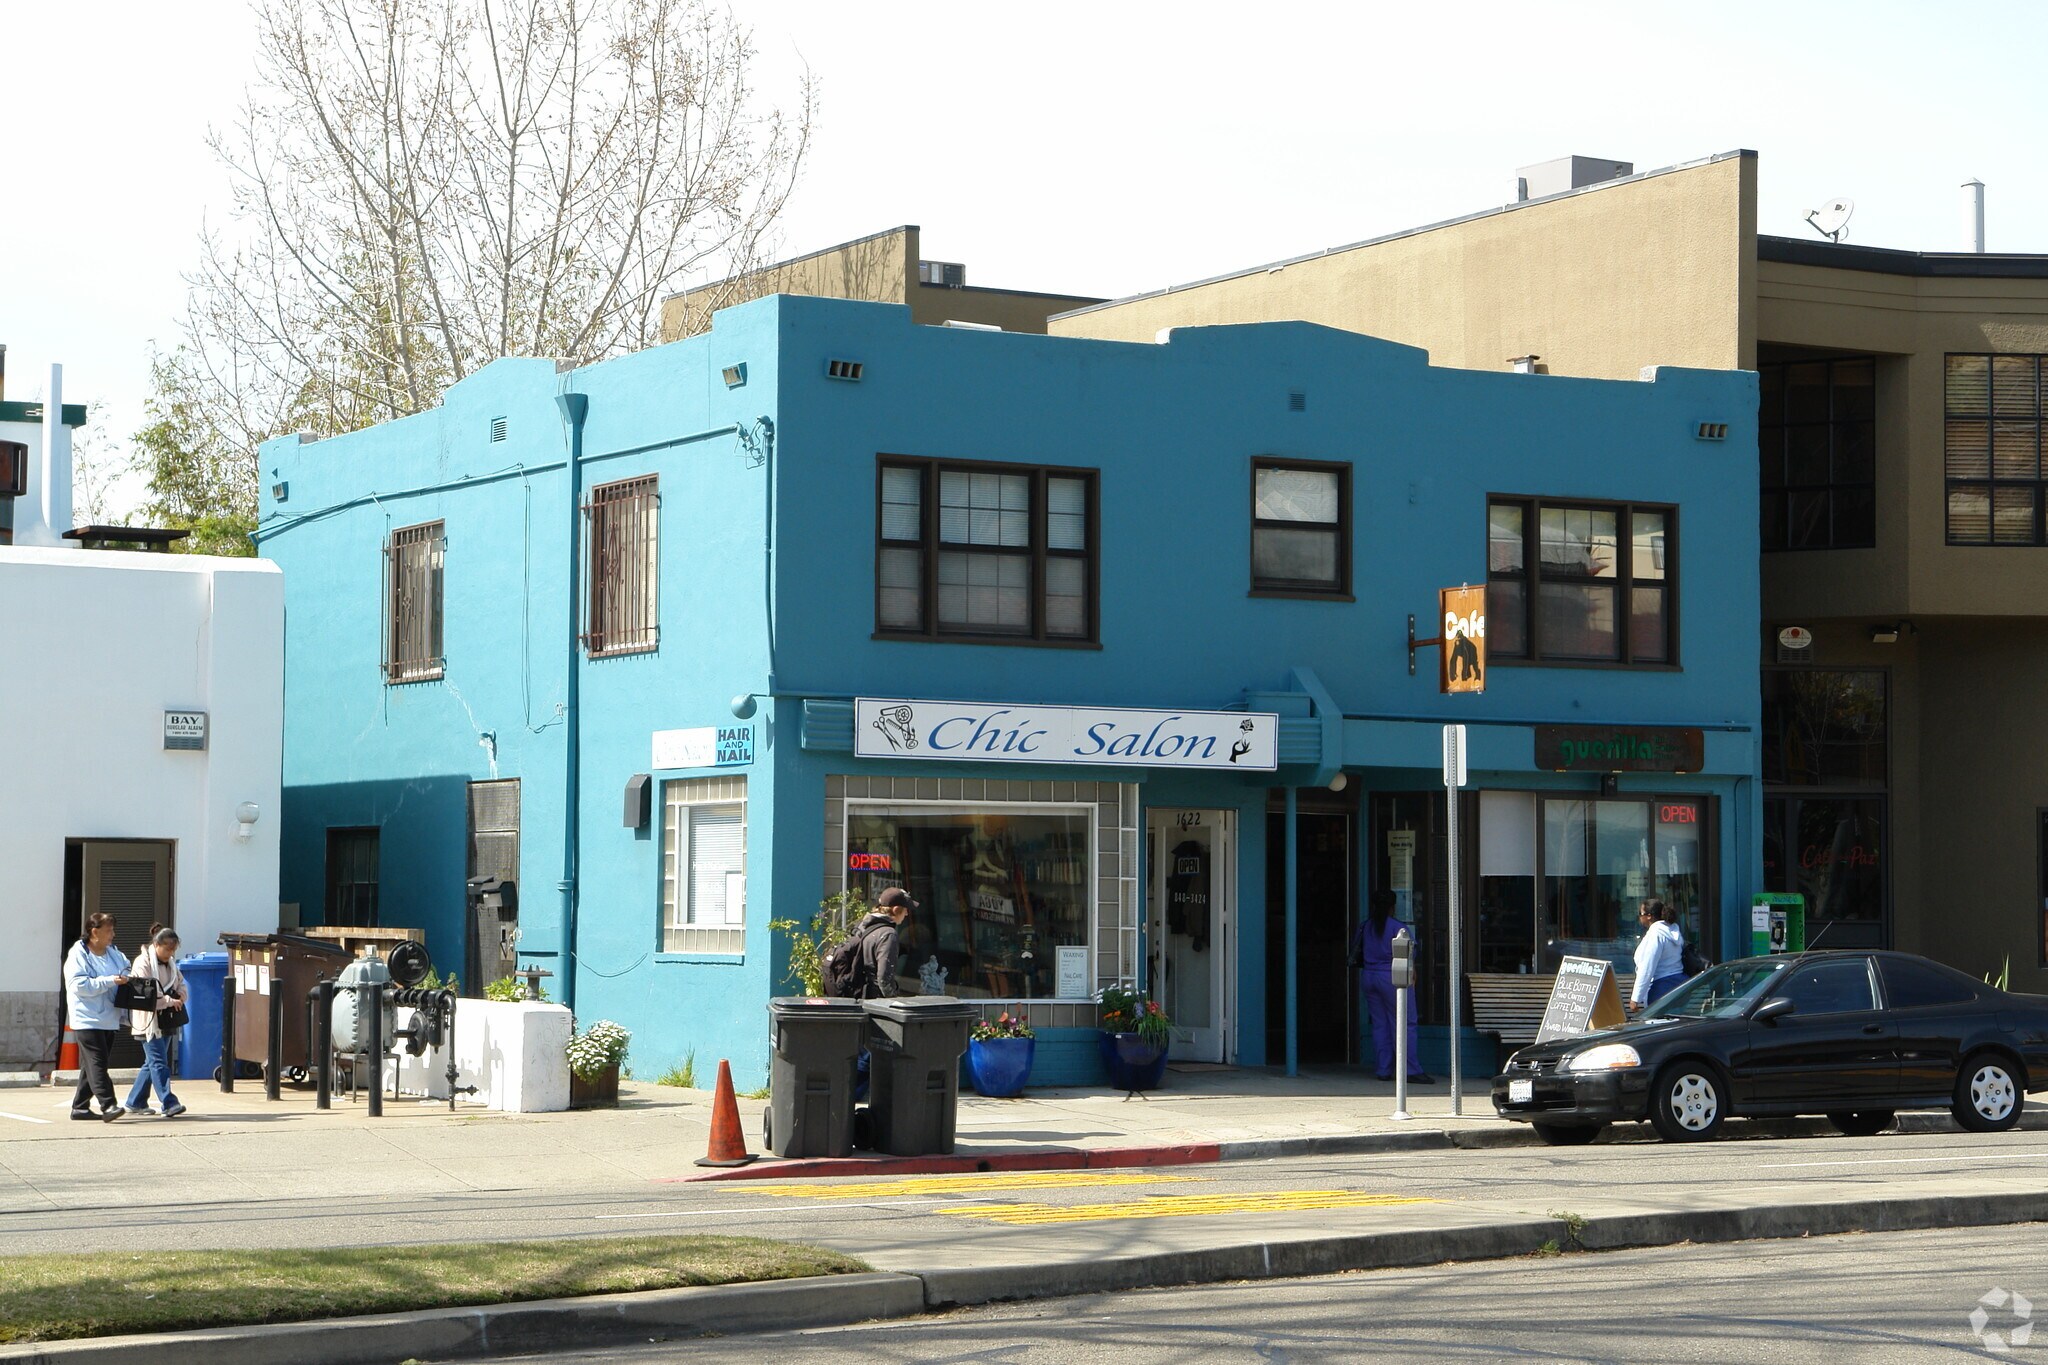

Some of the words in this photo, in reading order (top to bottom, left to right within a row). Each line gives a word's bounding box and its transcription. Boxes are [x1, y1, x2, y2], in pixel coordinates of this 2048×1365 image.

[1445, 609, 1485, 640] Cafe
[172, 716, 199, 724] BAY
[718, 728, 750, 742] HAIR
[928, 710, 1048, 753] Chic
[1074, 716, 1217, 759] Salon
[724, 740, 744, 749] AND
[1559, 733, 1653, 767] guerilla
[717, 748, 751, 762] NAIL
[1177, 812, 1201, 826] 1622
[1661, 805, 1696, 823] OPEN
[850, 853, 891, 869] OPEN
[1180, 859, 1199, 873] OPEN
[1560, 961, 1593, 975] guerilla
[1558, 976, 1573, 990] BLUE
[1573, 979, 1596, 993] BOTTLE
[1550, 998, 1570, 1011] COFFEE
